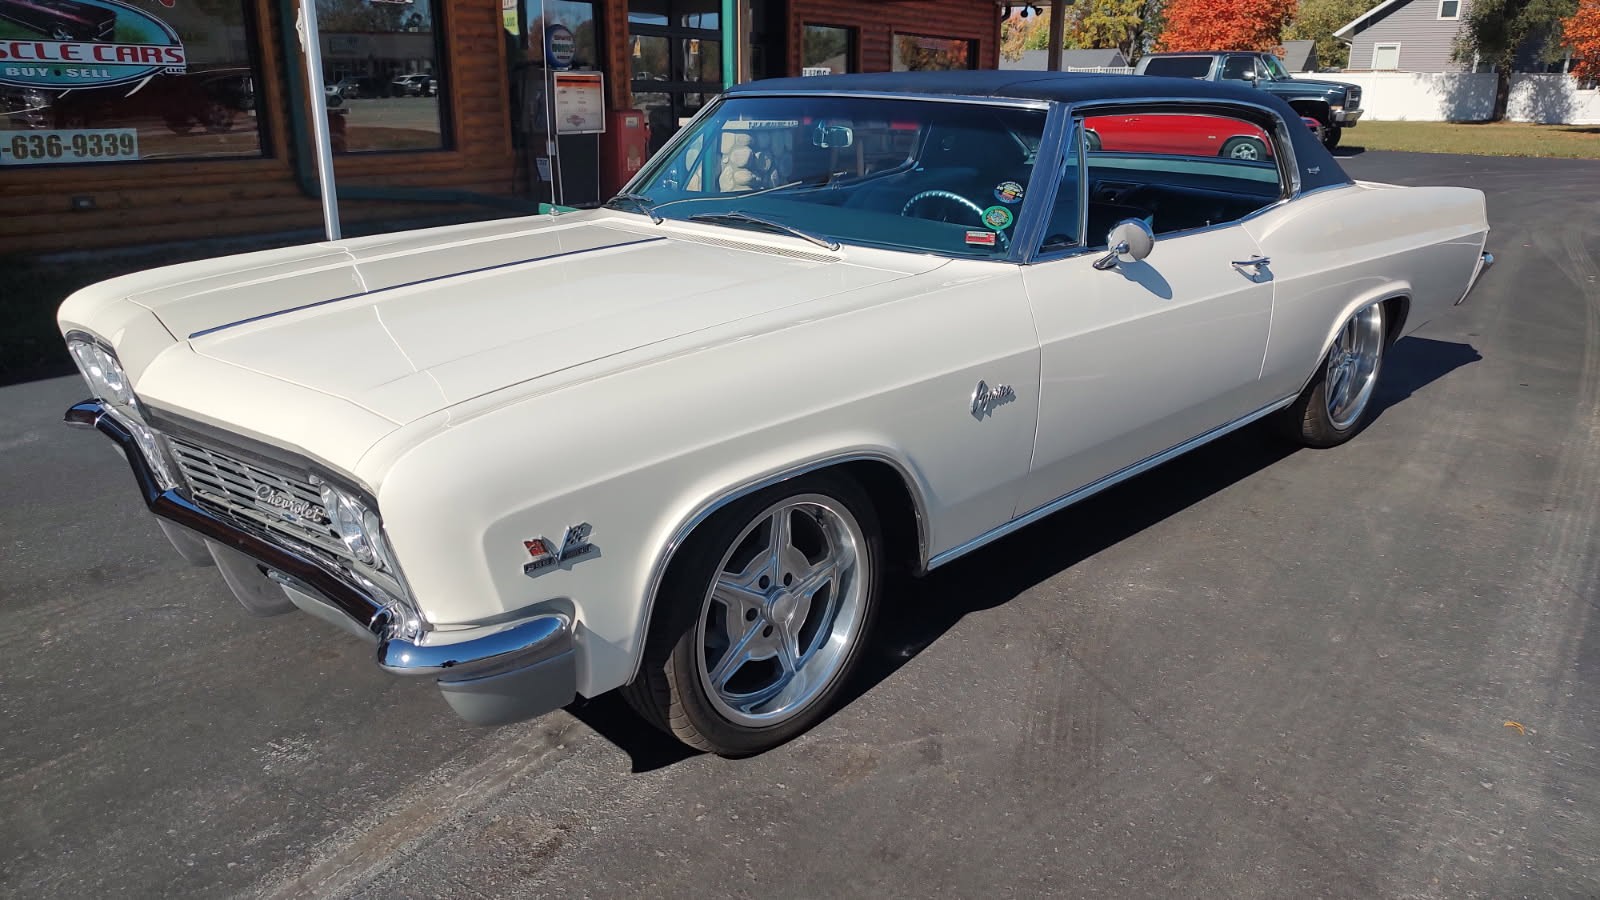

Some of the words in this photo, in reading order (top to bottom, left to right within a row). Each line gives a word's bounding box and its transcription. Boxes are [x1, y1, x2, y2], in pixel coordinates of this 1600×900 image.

[93, 45, 184, 64] CARS
[5, 67, 49, 78] BUY
[66, 68, 112, 79] SELL
[0, 133, 135, 160] -636-9339
[256, 483, 325, 523] Chevrolet
